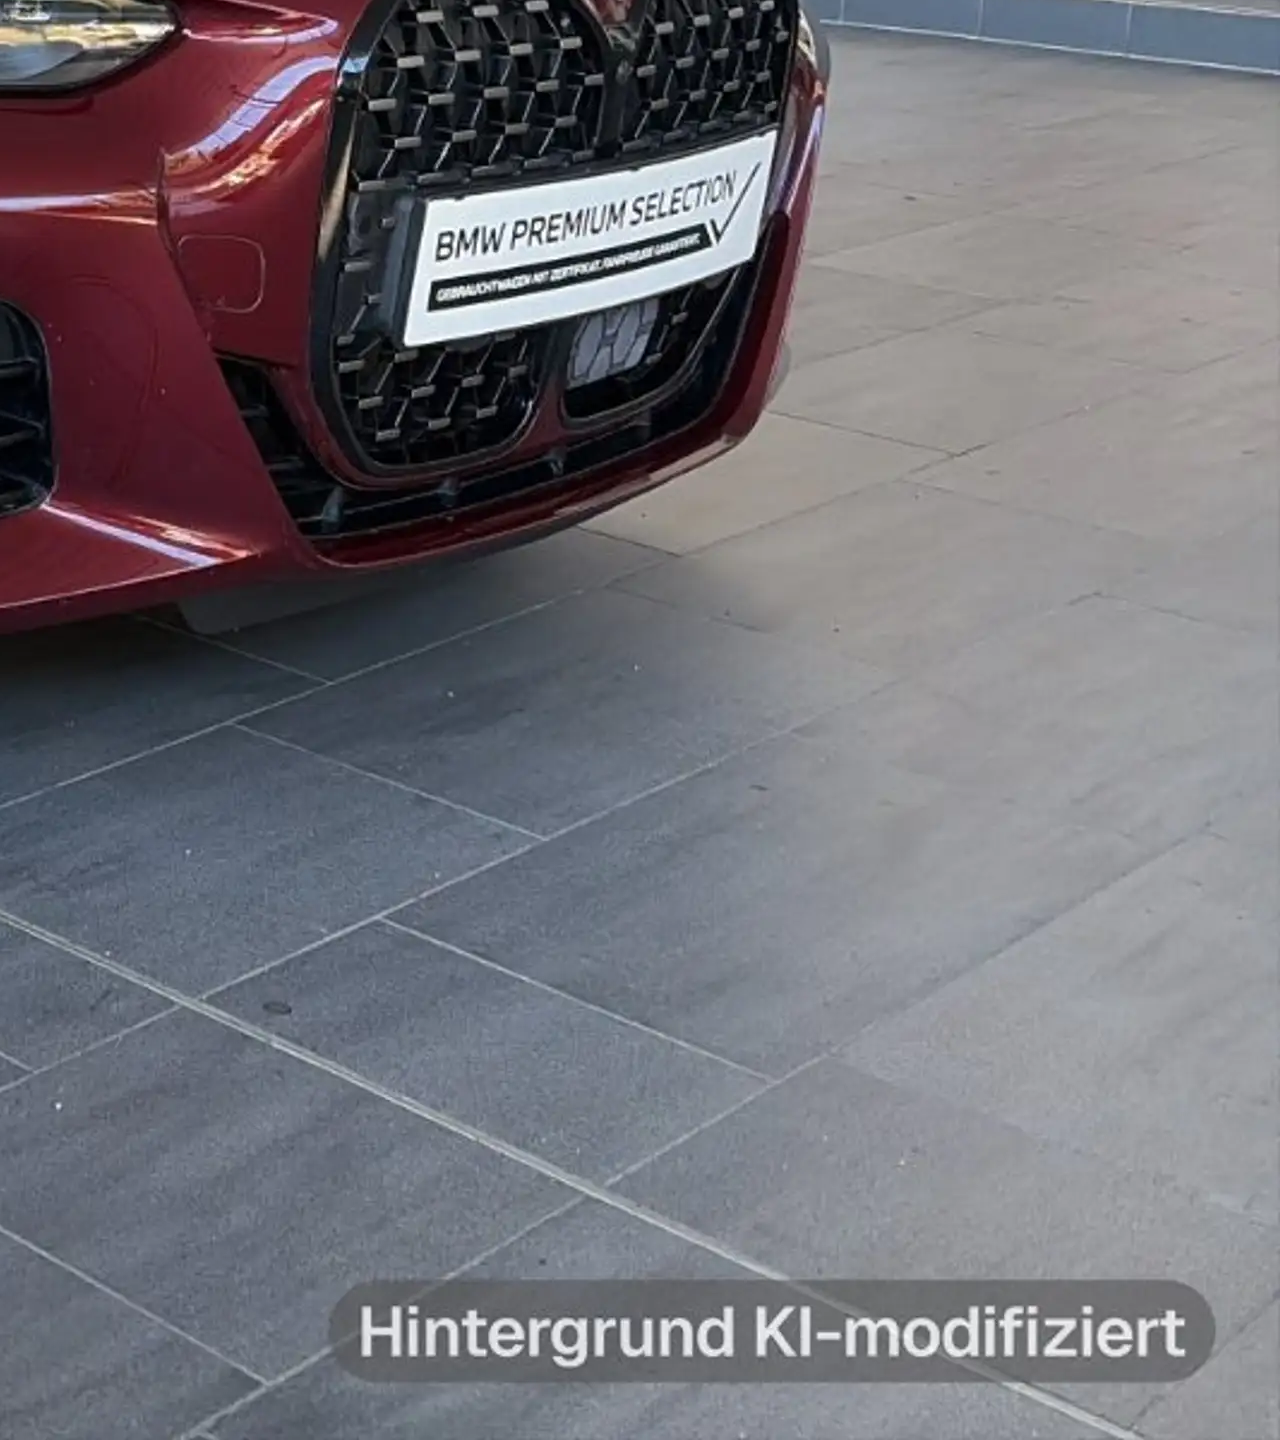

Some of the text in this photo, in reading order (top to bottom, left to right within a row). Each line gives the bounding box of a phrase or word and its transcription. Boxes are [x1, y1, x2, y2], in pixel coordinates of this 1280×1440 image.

[435, 170, 738, 262] BMW PREMIUM SELECTION
